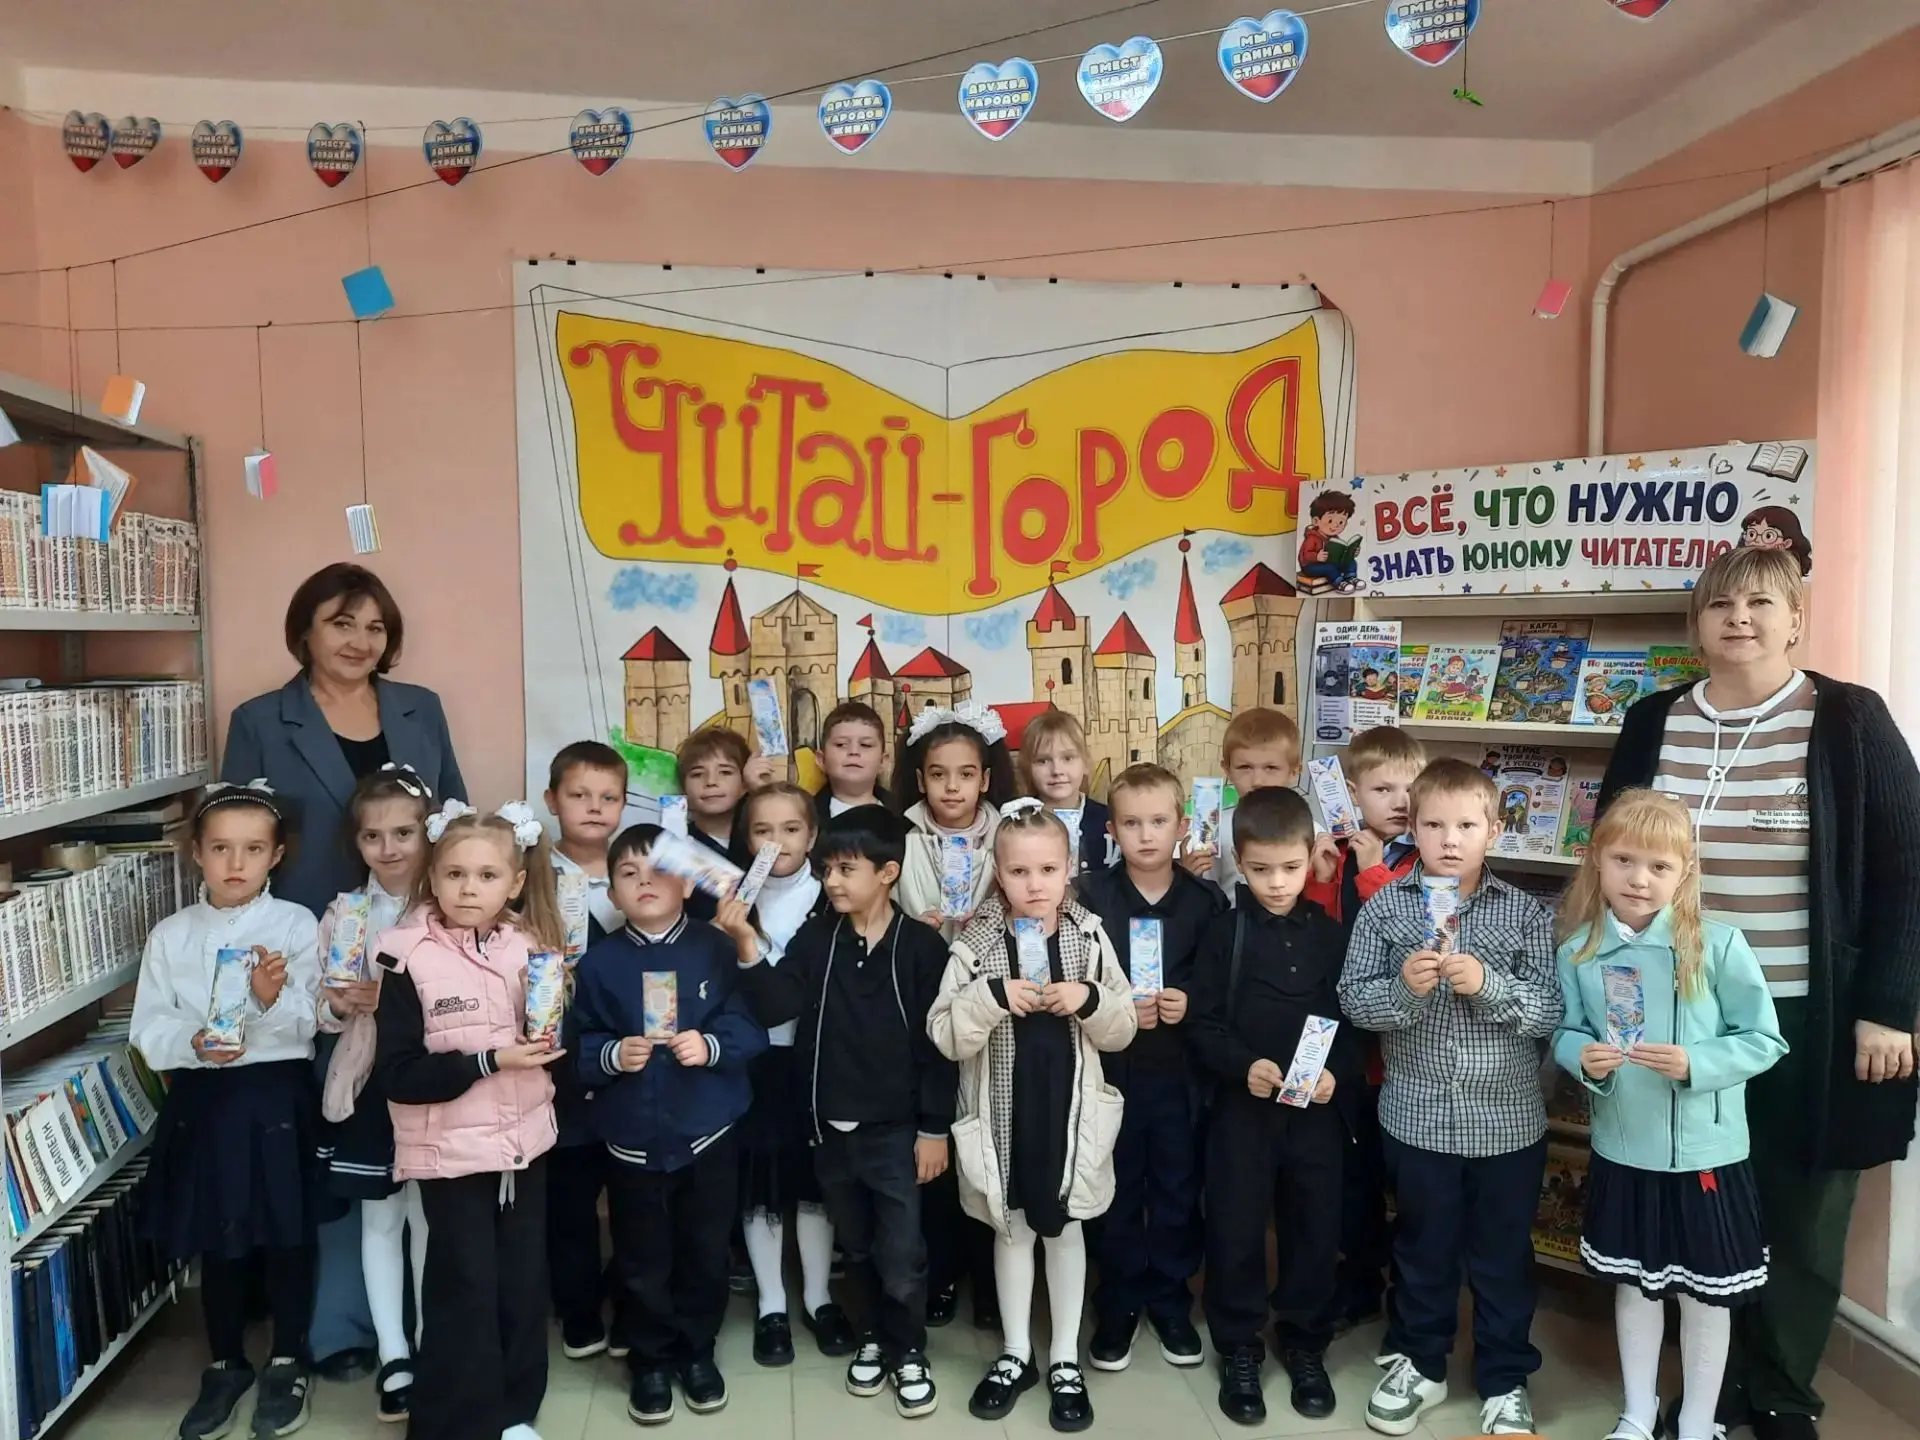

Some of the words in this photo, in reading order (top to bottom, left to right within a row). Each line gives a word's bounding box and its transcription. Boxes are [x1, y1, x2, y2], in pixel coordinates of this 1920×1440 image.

[1401, 12, 1466, 31] КВОЗЬ
[1240, 32, 1268, 48] МЫ
[1232, 41, 1294, 64] ЕДИНАЯ
[1231, 56, 1299, 80] СТРАНА!
[968, 77, 1028, 95] ДРУЖБА
[826, 95, 884, 112] ДРУЖБА
[965, 91, 1032, 109] НАРОДОВ
[719, 111, 742, 122] МЫ
[823, 108, 885, 125] НАРОДОВ
[975, 106, 1022, 122] ЖИВА!
[713, 123, 763, 135] ЕДИНАЯ
[830, 121, 877, 136] ЖИВА!
[712, 136, 764, 149] СТРАНА!
[1375, 483, 1468, 542] ВСЁ,
[1474, 485, 1555, 528] ЧТО
[1568, 481, 1739, 523] НУЖНО
[1368, 546, 1455, 583] ЗНАТЬ
[1462, 538, 1573, 573] ЮНОМУ
[1336, 625, 1358, 633] ОДИН
[1360, 625, 1380, 633] ДЕНЬ
[1530, 622, 1558, 630] КАРТА
[1363, 634, 1397, 642] КНИГАМИ!
[1427, 708, 1474, 717] КРАСНАЯ
[1502, 745, 1541, 754] ЧТЕНИЕ
[435, 996, 463, 1010] COOL
[117, 1065, 149, 1121] ГЕОГРАФИЯ
[42, 1121, 73, 1188] ПИСАТЕЛИ
